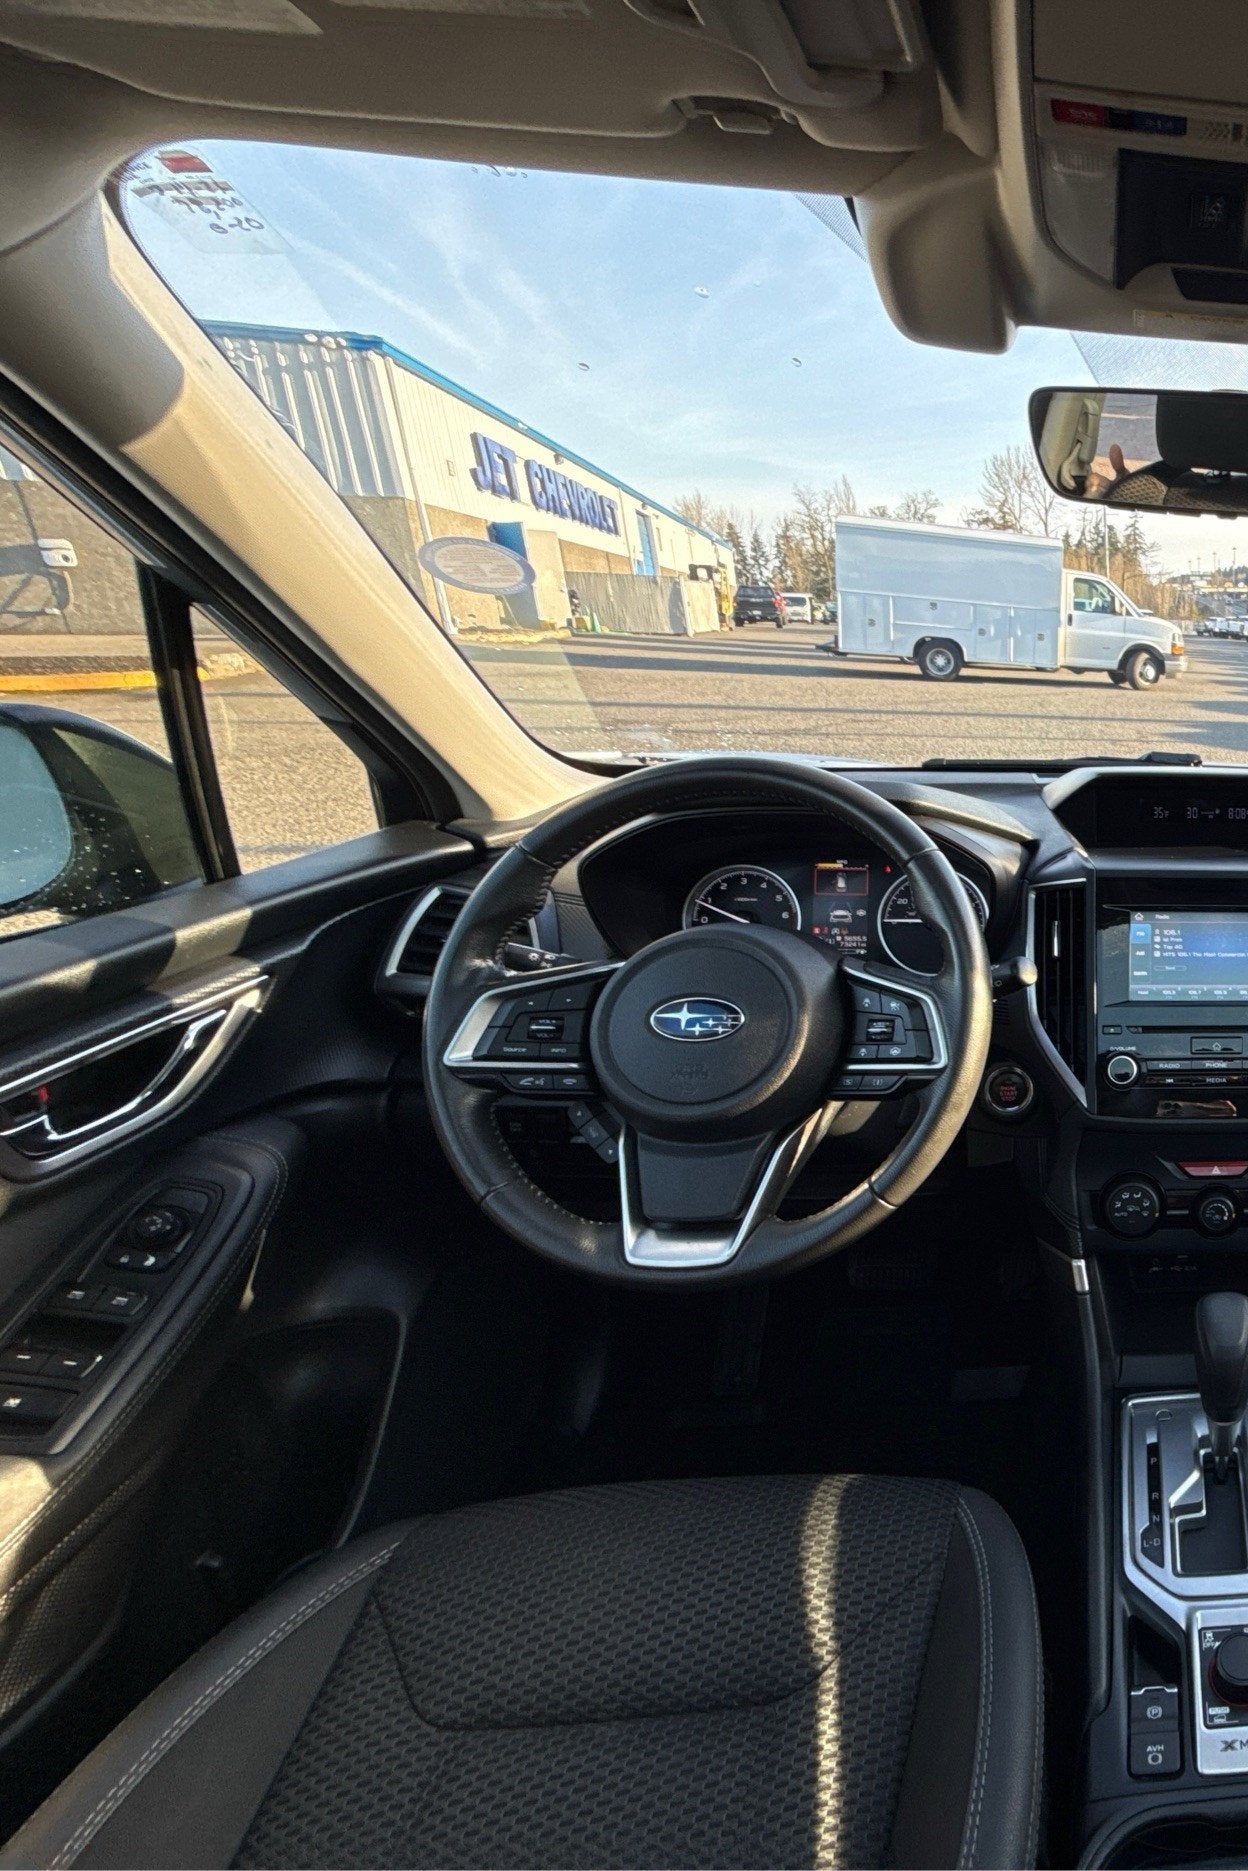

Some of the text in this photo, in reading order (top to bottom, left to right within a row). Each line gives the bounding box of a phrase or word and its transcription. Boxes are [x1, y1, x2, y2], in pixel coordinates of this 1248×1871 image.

[469, 432, 621, 536] JET CHEVROLET
[1150, 1457, 1157, 1465] P
[1152, 1492, 1159, 1500] R
[1146, 1744, 1164, 1752] AVH
